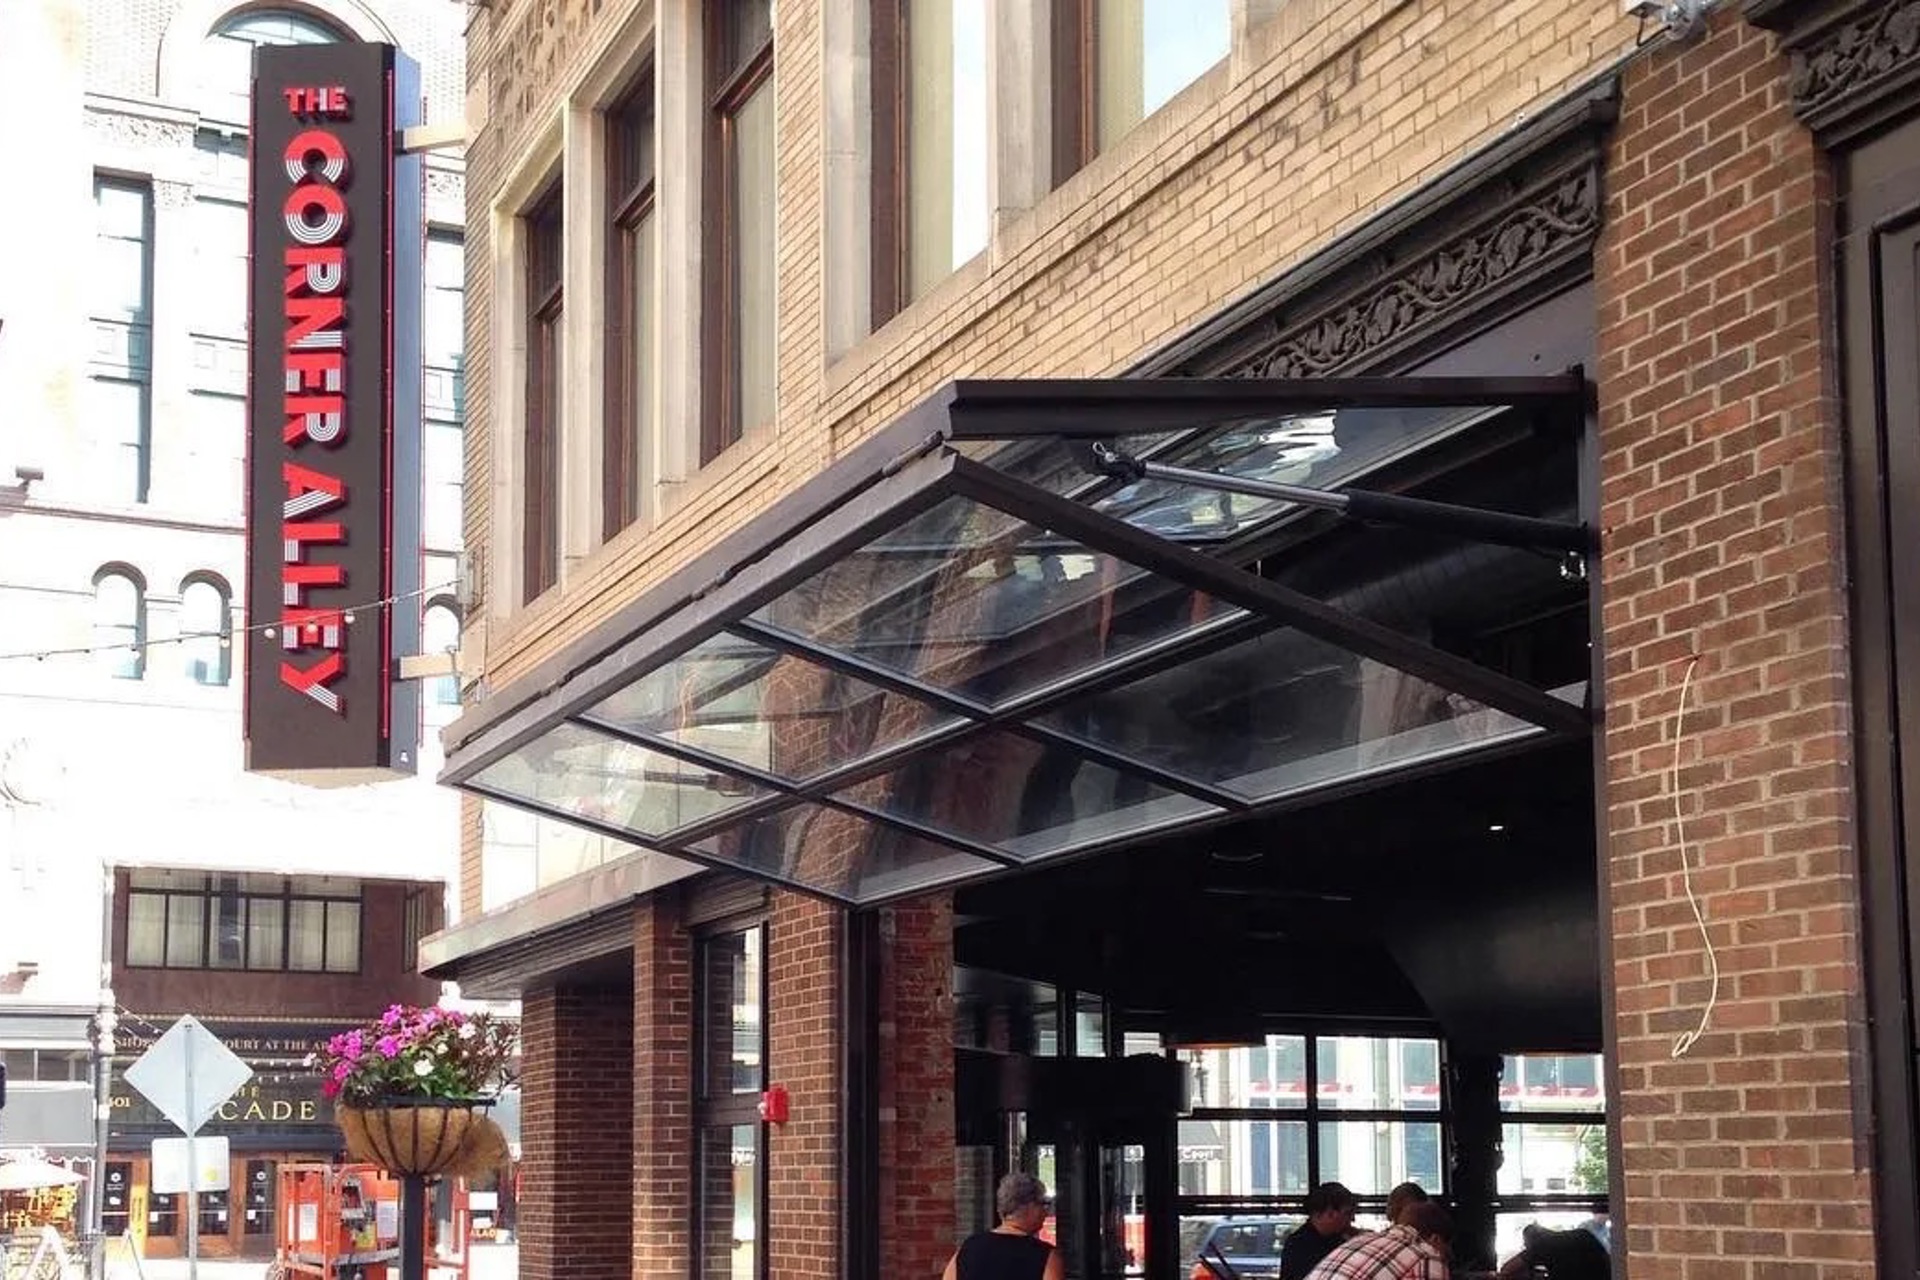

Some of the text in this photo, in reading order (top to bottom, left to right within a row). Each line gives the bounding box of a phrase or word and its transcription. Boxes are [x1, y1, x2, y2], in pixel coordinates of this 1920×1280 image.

[284, 87, 349, 116] THE
[279, 129, 349, 717] CORNER ALLEY
[225, 1039, 260, 1050] OURT
[264, 1040, 280, 1050] AT
[284, 1040, 306, 1051] THE
[216, 1100, 316, 1121] CADE
